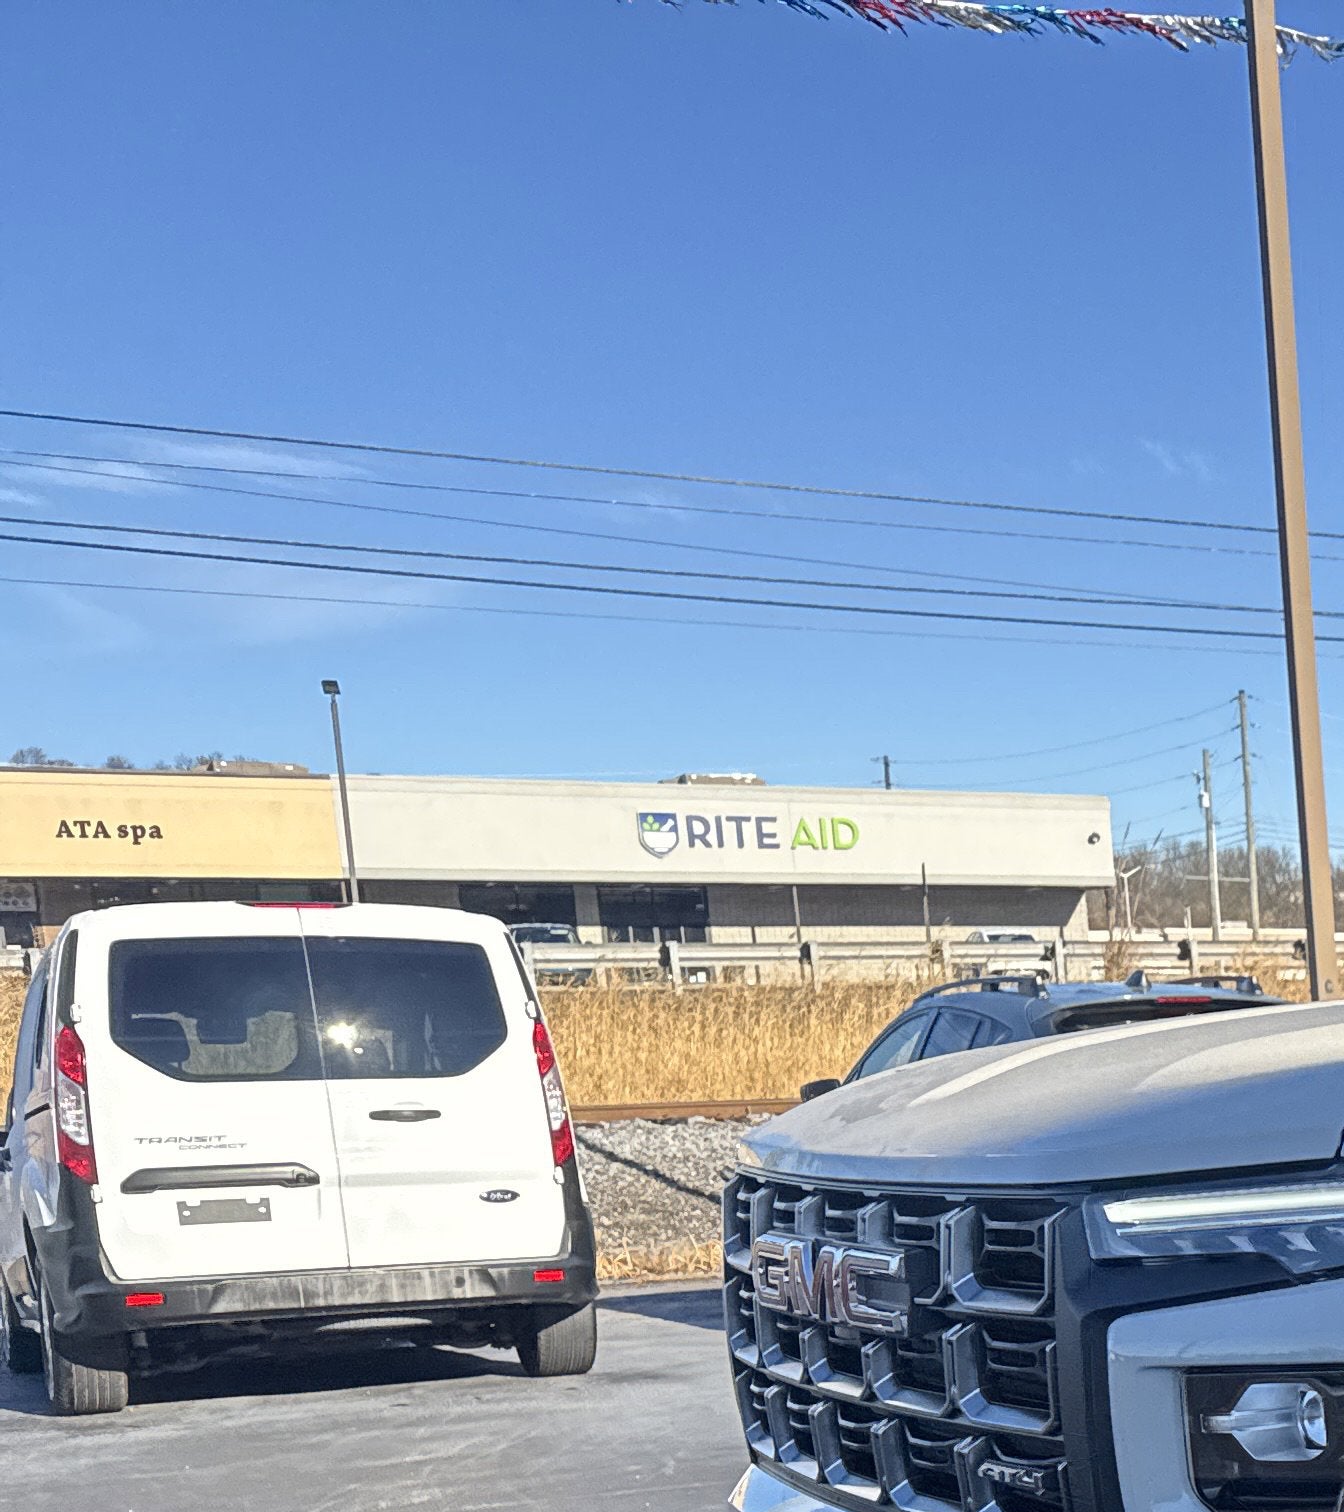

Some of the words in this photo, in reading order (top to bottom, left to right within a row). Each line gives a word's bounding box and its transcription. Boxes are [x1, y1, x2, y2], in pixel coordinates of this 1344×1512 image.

[55, 819, 112, 839] ATA
[116, 824, 164, 846] spa
[685, 814, 781, 850] RITE
[790, 816, 860, 851] AID
[133, 1134, 228, 1146] TRANSIT
[178, 1142, 248, 1151] CONNECT
[751, 1233, 907, 1336] GMC
[977, 1461, 1046, 1497] AT4
